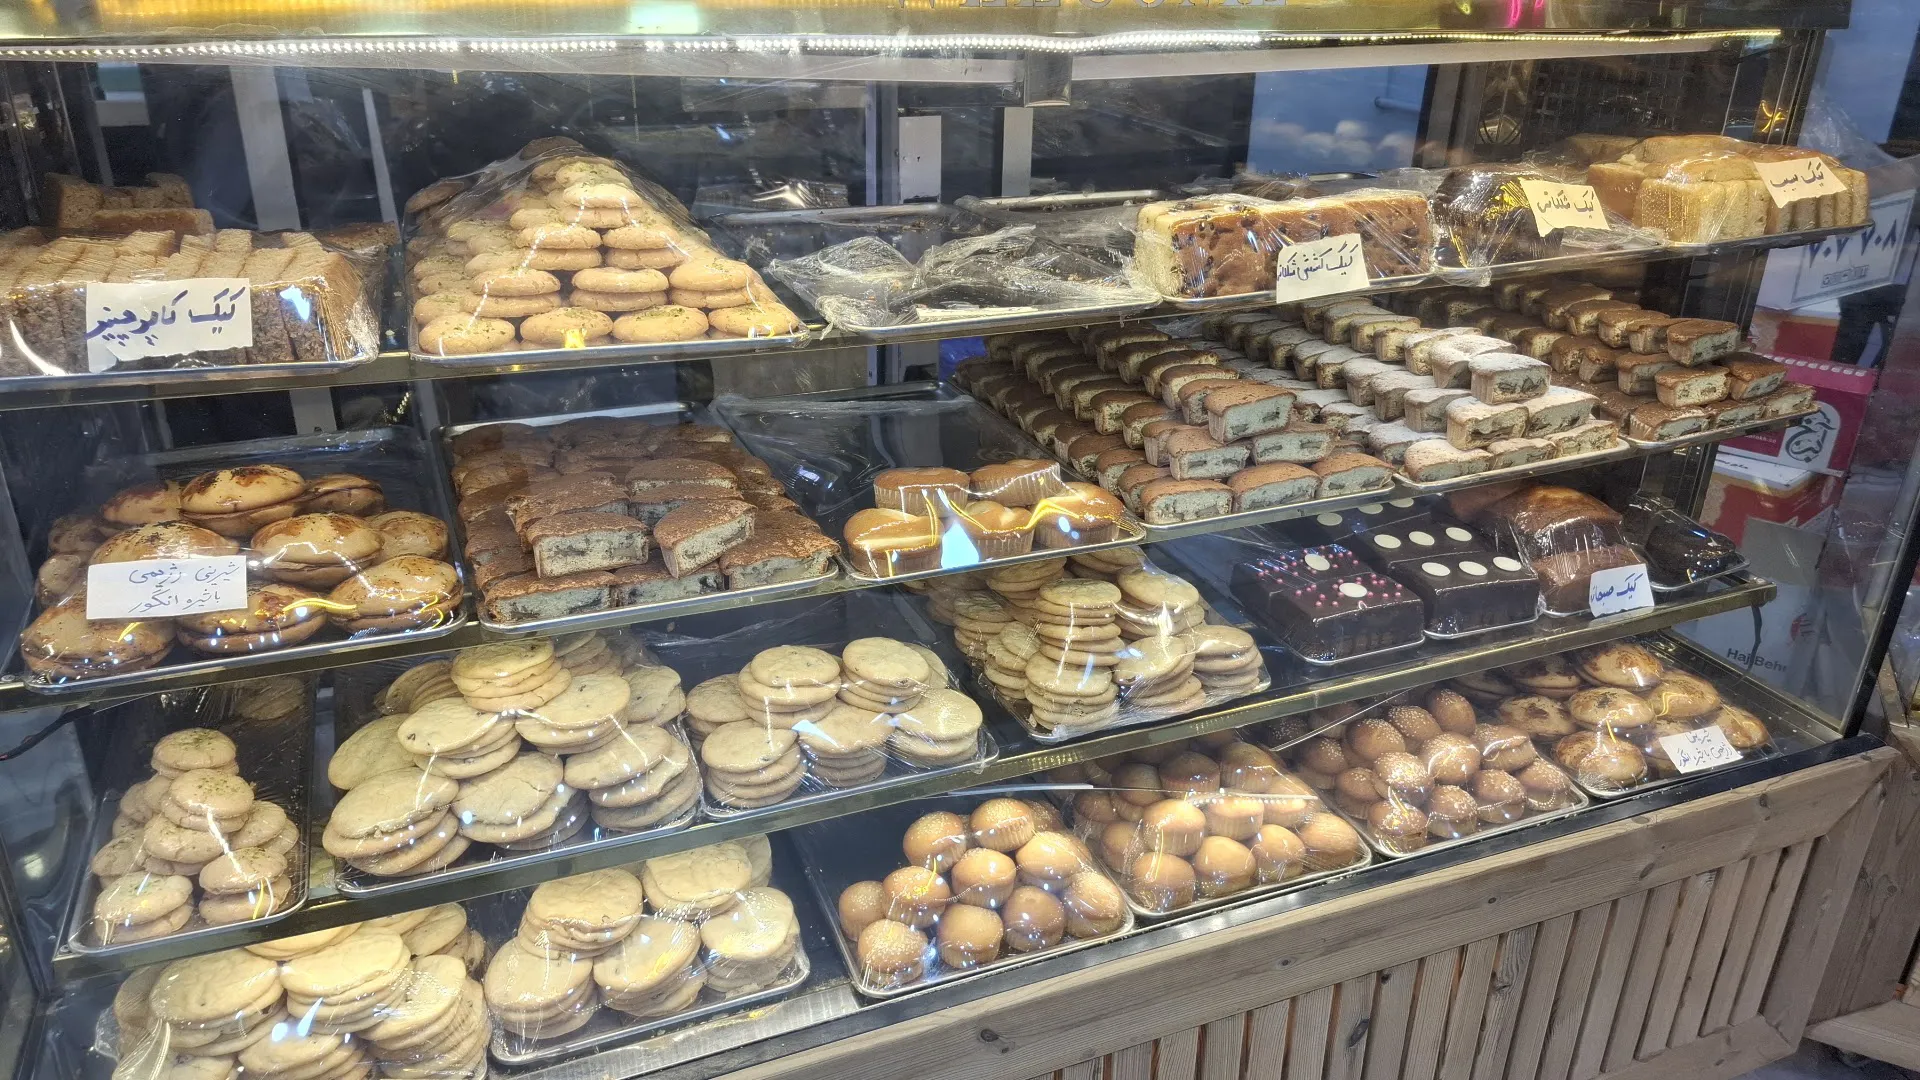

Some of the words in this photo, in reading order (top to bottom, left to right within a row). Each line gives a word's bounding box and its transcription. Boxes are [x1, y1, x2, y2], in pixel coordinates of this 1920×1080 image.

[1326, 241, 1359, 275] کیک
[188, 286, 246, 334] کیک
[195, 561, 240, 586] شیرینی
[1616, 572, 1644, 600] کیک
[128, 588, 179, 614] انگور
[1726, 647, 1751, 666] Haj
